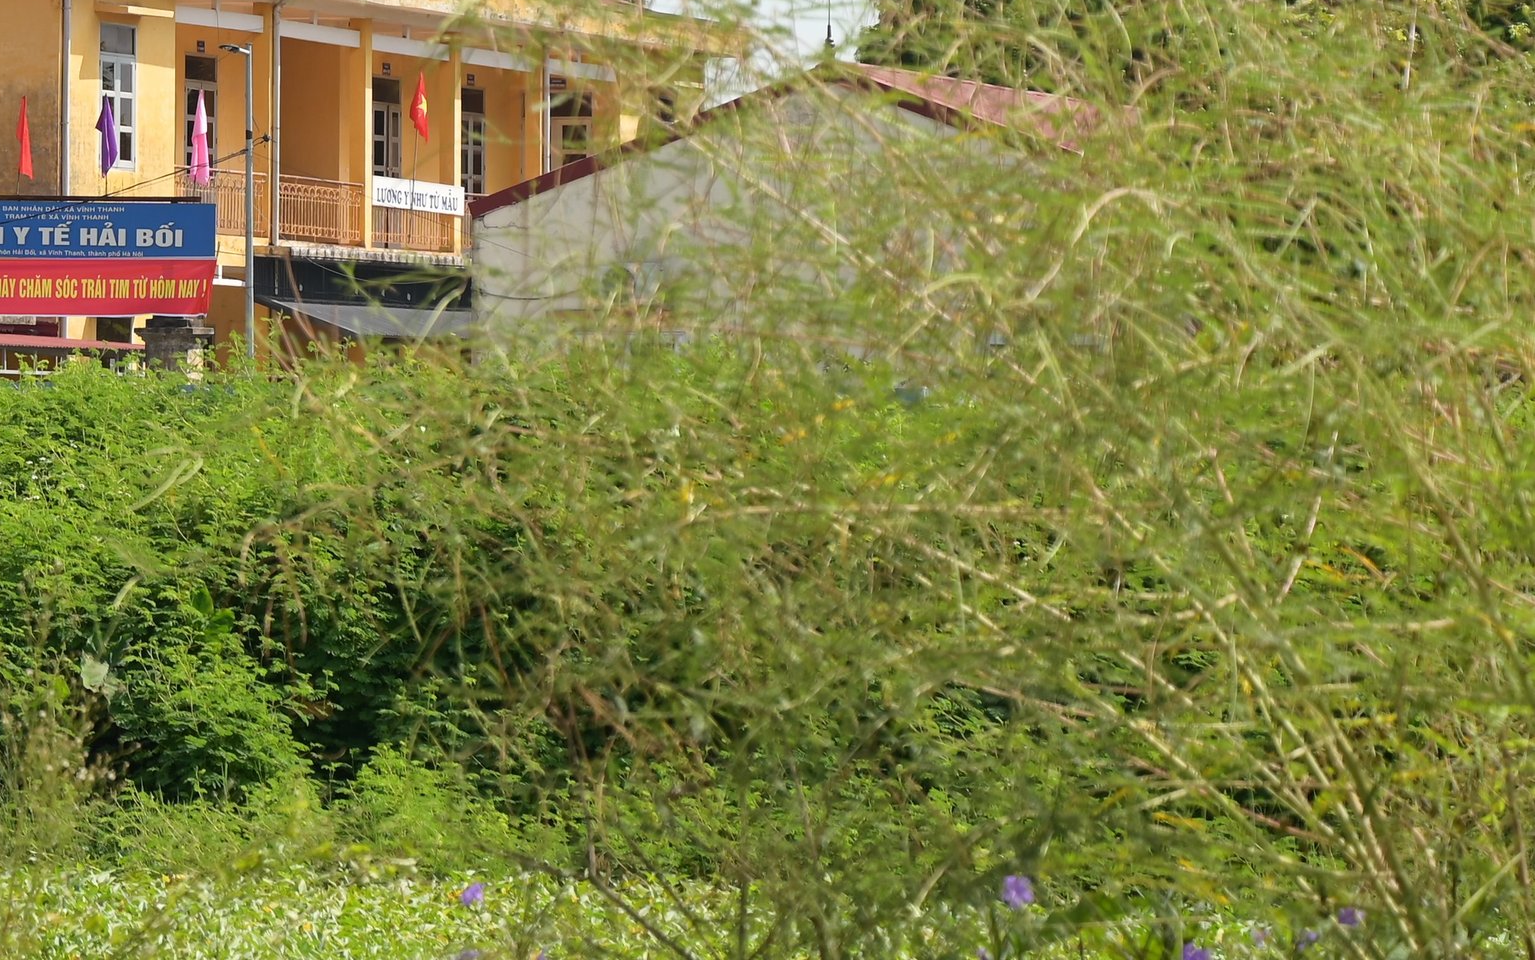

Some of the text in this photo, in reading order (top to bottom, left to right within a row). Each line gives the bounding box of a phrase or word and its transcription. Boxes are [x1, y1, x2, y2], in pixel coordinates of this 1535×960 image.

[97, 206, 125, 214] THANH
[13, 226, 31, 245] Y
[38, 221, 73, 246] TẾ
[79, 222, 127, 247] HẢI
[136, 222, 183, 248] BỐI
[19, 274, 52, 298] CHĂM
[55, 274, 78, 299] SÓC
[81, 274, 106, 299] TRÁI
[109, 279, 130, 299] TIM
[133, 275, 148, 299] TỪ
[150, 275, 176, 299] HÔM
[178, 279, 200, 299] NAY
